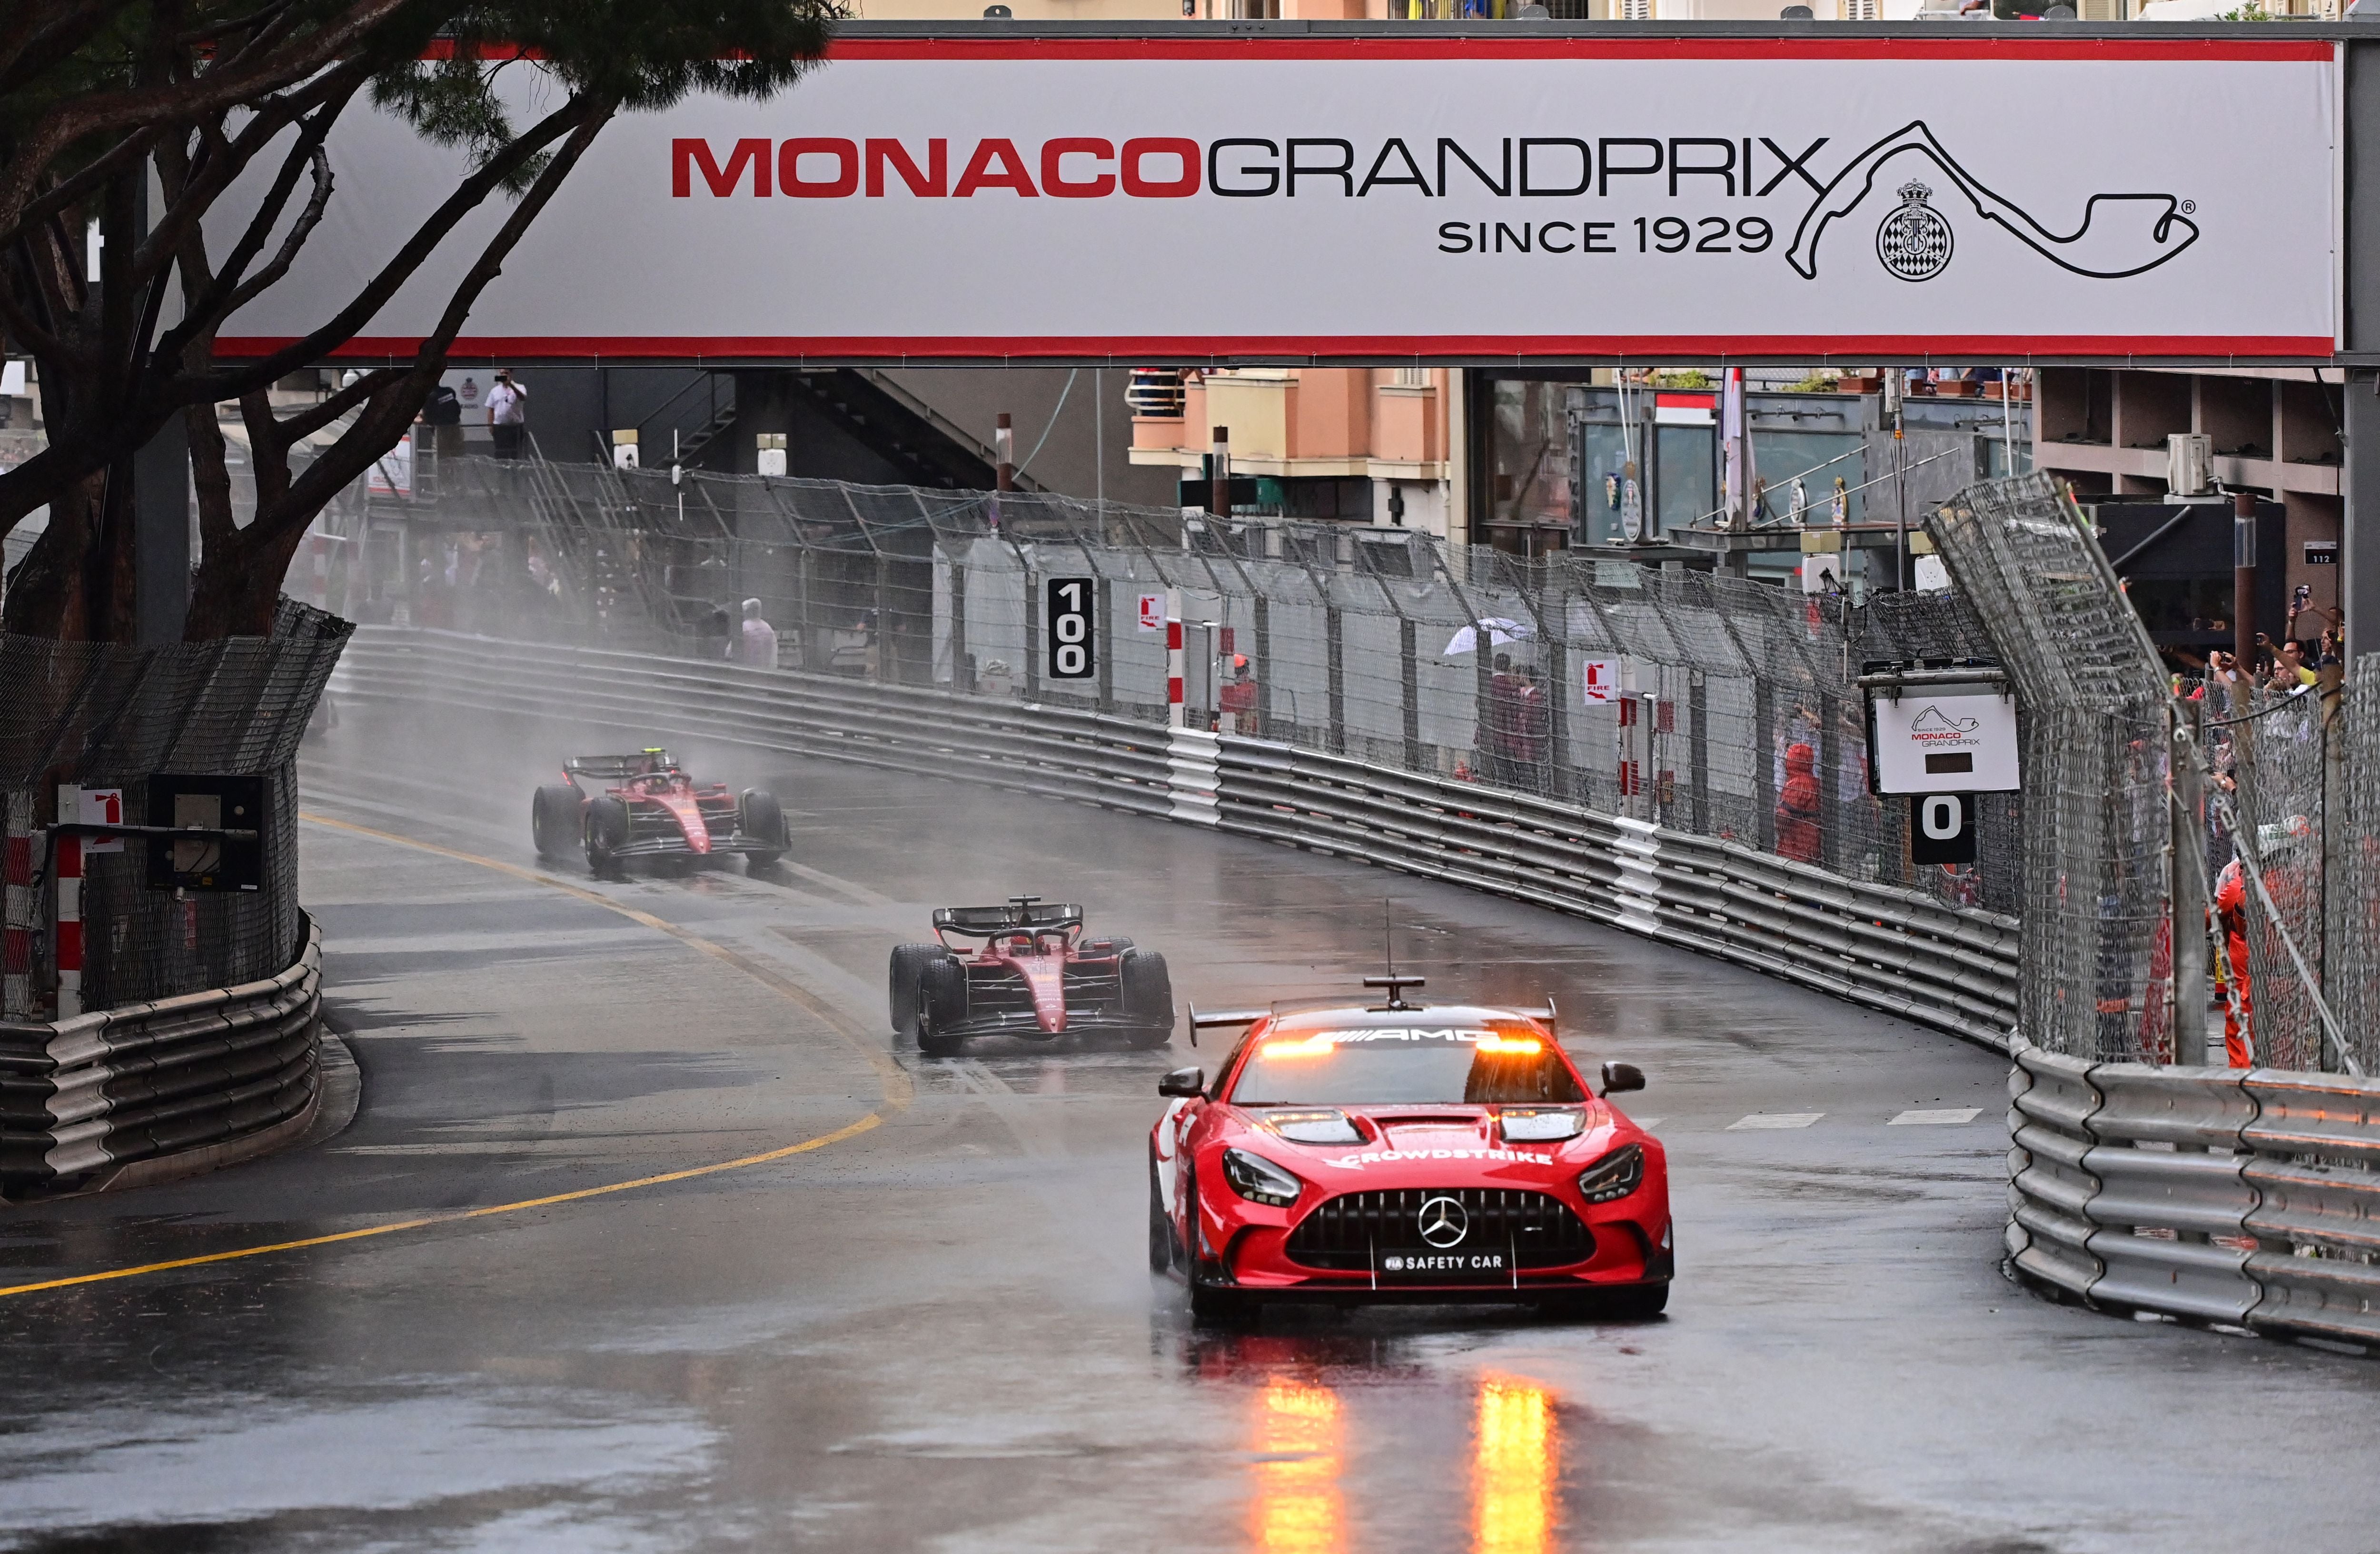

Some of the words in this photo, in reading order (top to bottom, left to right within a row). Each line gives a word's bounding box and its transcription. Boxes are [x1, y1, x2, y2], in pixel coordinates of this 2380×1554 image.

[1438, 221, 1616, 253] SINCE
[1634, 217, 1773, 253] 1929
[1912, 732, 1961, 740] MONACO
[1922, 738, 1980, 747] GRANDPRIX
[1922, 796, 1962, 840] 0
[1365, 1029, 1500, 1042] AMG
[1342, 1148, 1553, 1166] CROWDSTRIKE
[1385, 1259, 1402, 1269] FIA
[1406, 1256, 1465, 1270] SAFETY
[1471, 1255, 1502, 1268] CAR
